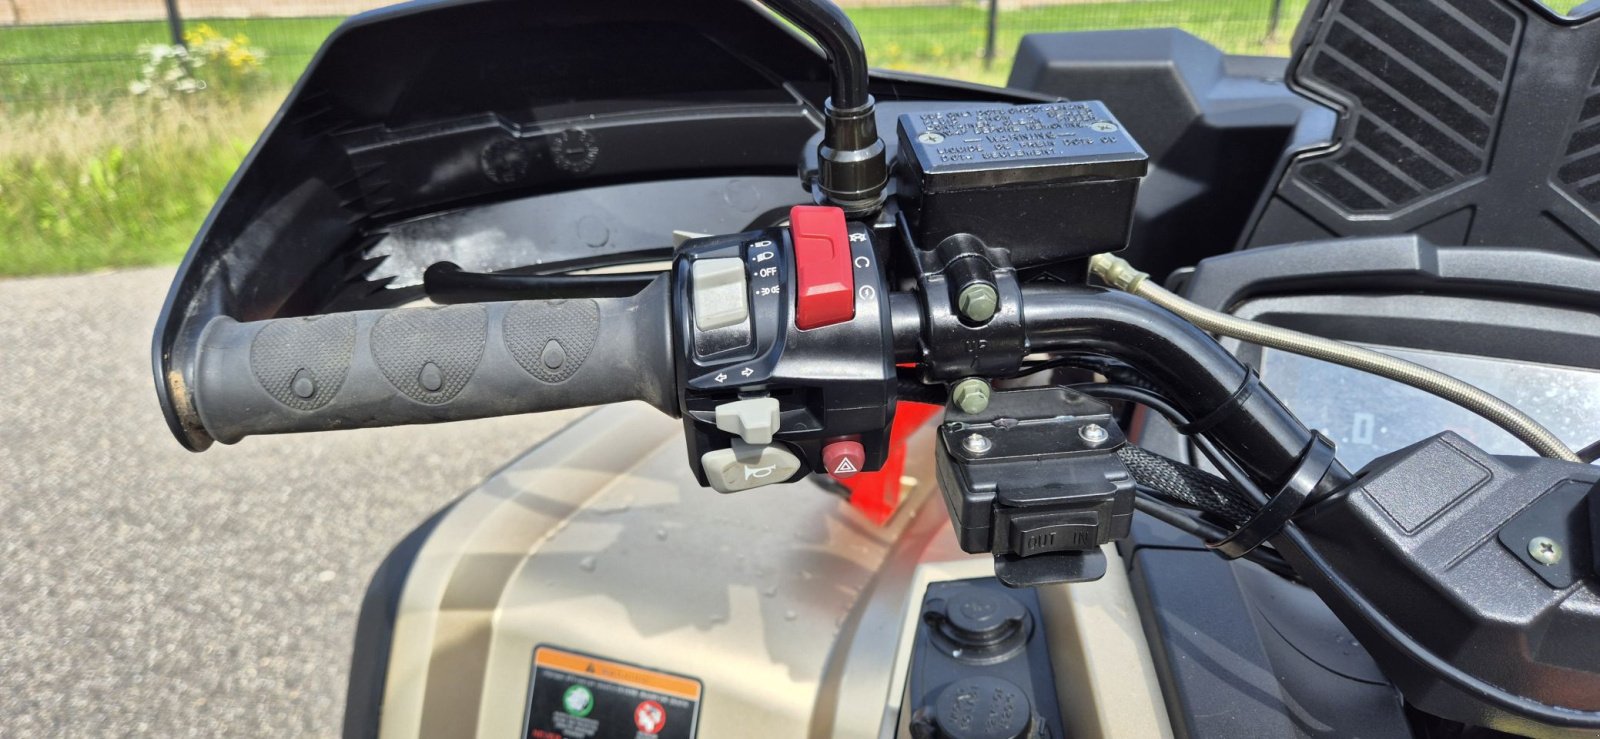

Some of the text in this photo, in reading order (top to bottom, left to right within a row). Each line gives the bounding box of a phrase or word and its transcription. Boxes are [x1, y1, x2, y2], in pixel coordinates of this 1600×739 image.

[760, 267, 777, 277] OFF
[1027, 530, 1089, 550] OUT IN
